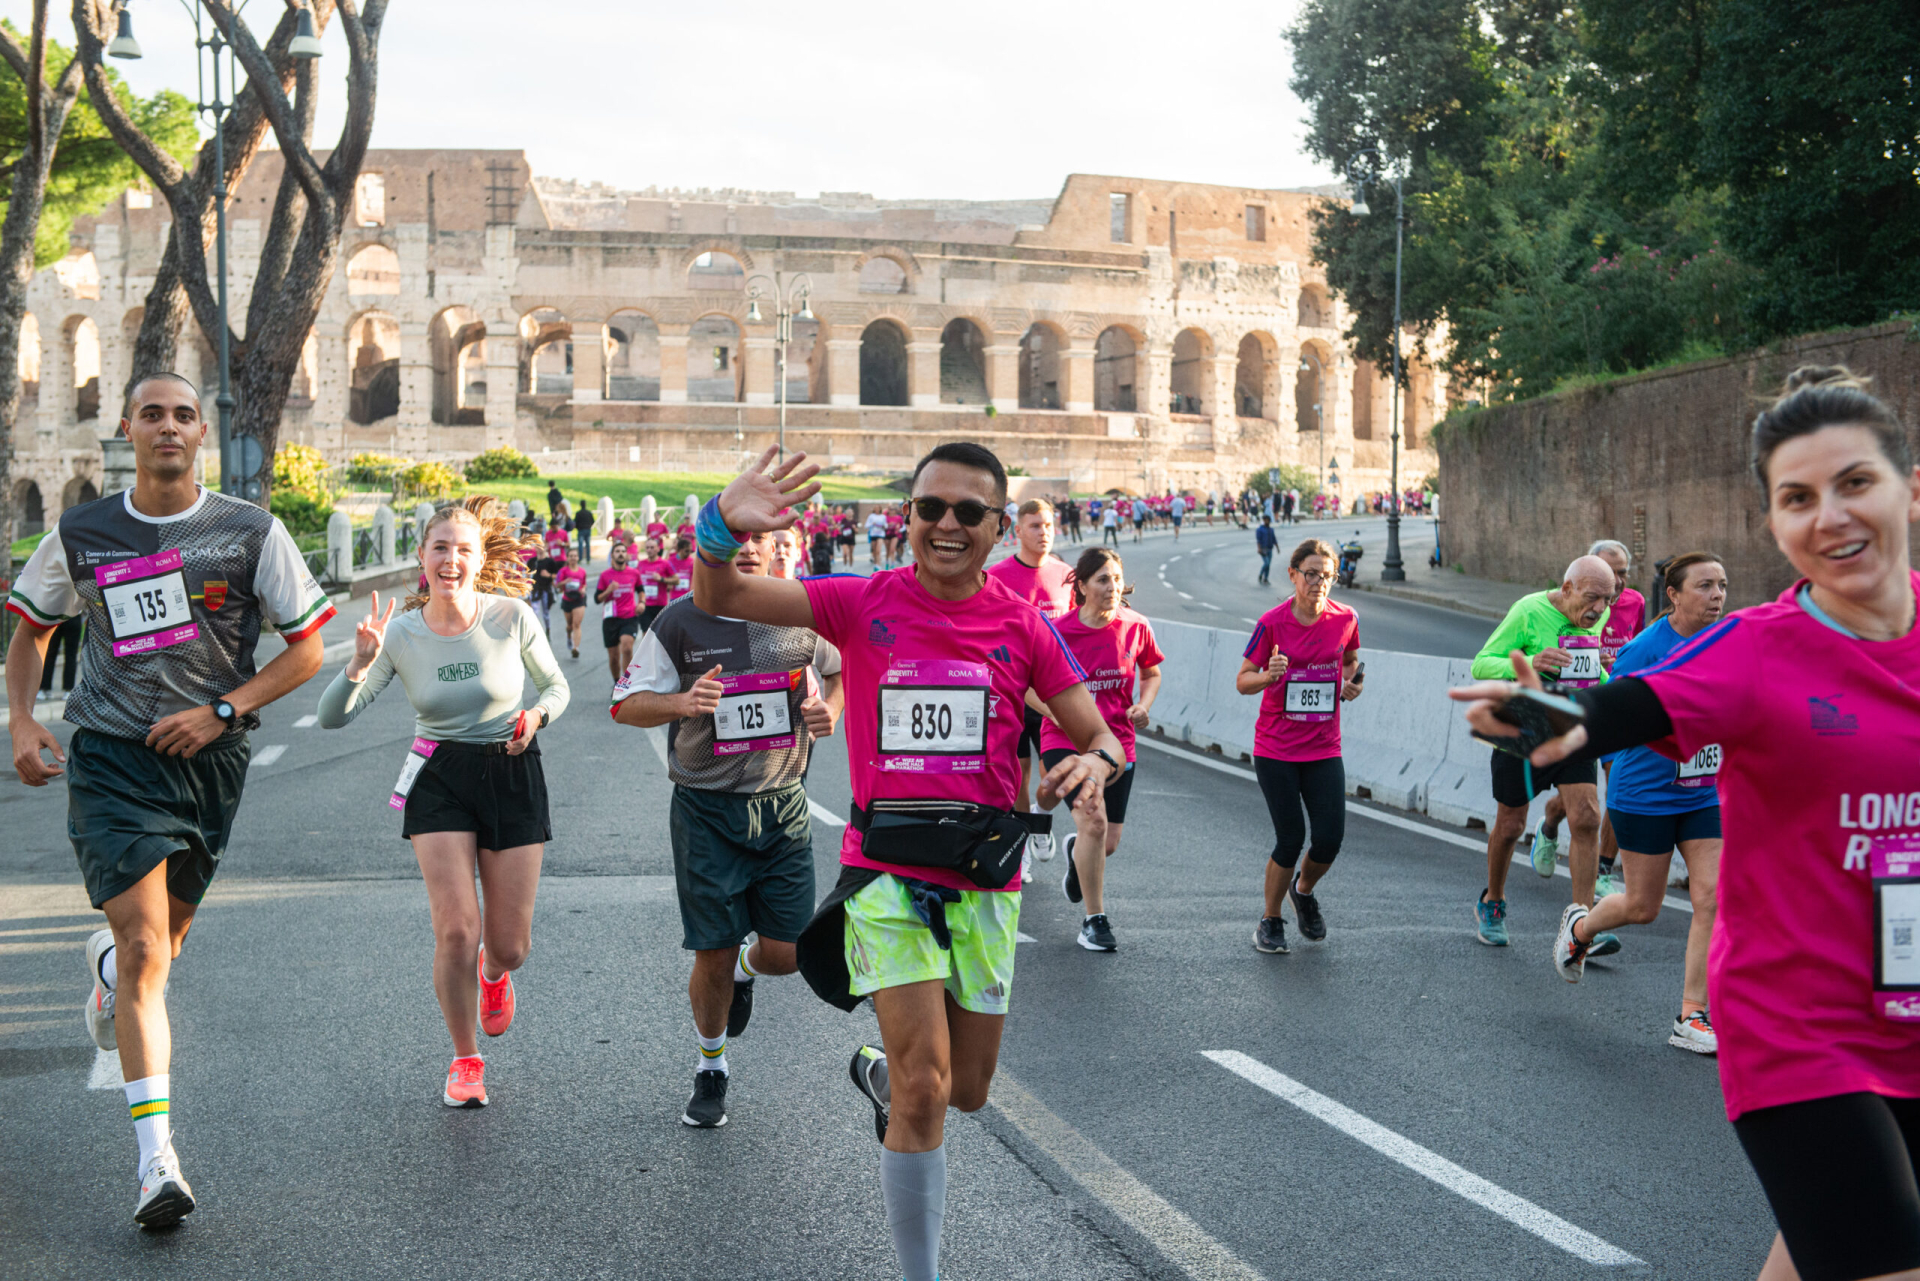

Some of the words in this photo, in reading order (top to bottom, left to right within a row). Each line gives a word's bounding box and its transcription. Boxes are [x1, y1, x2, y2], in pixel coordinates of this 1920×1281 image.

[180, 549, 220, 558] ROMA
[134, 589, 166, 622] 135
[438, 664, 456, 681] RUN
[1096, 666, 1126, 676] Gemelli
[1574, 655, 1590, 672] 270
[1301, 689, 1320, 706] 863
[738, 703, 764, 730] 125
[912, 703, 952, 740] 830
[1695, 746, 1717, 769] 1065
[1839, 791, 1920, 830] LONG
